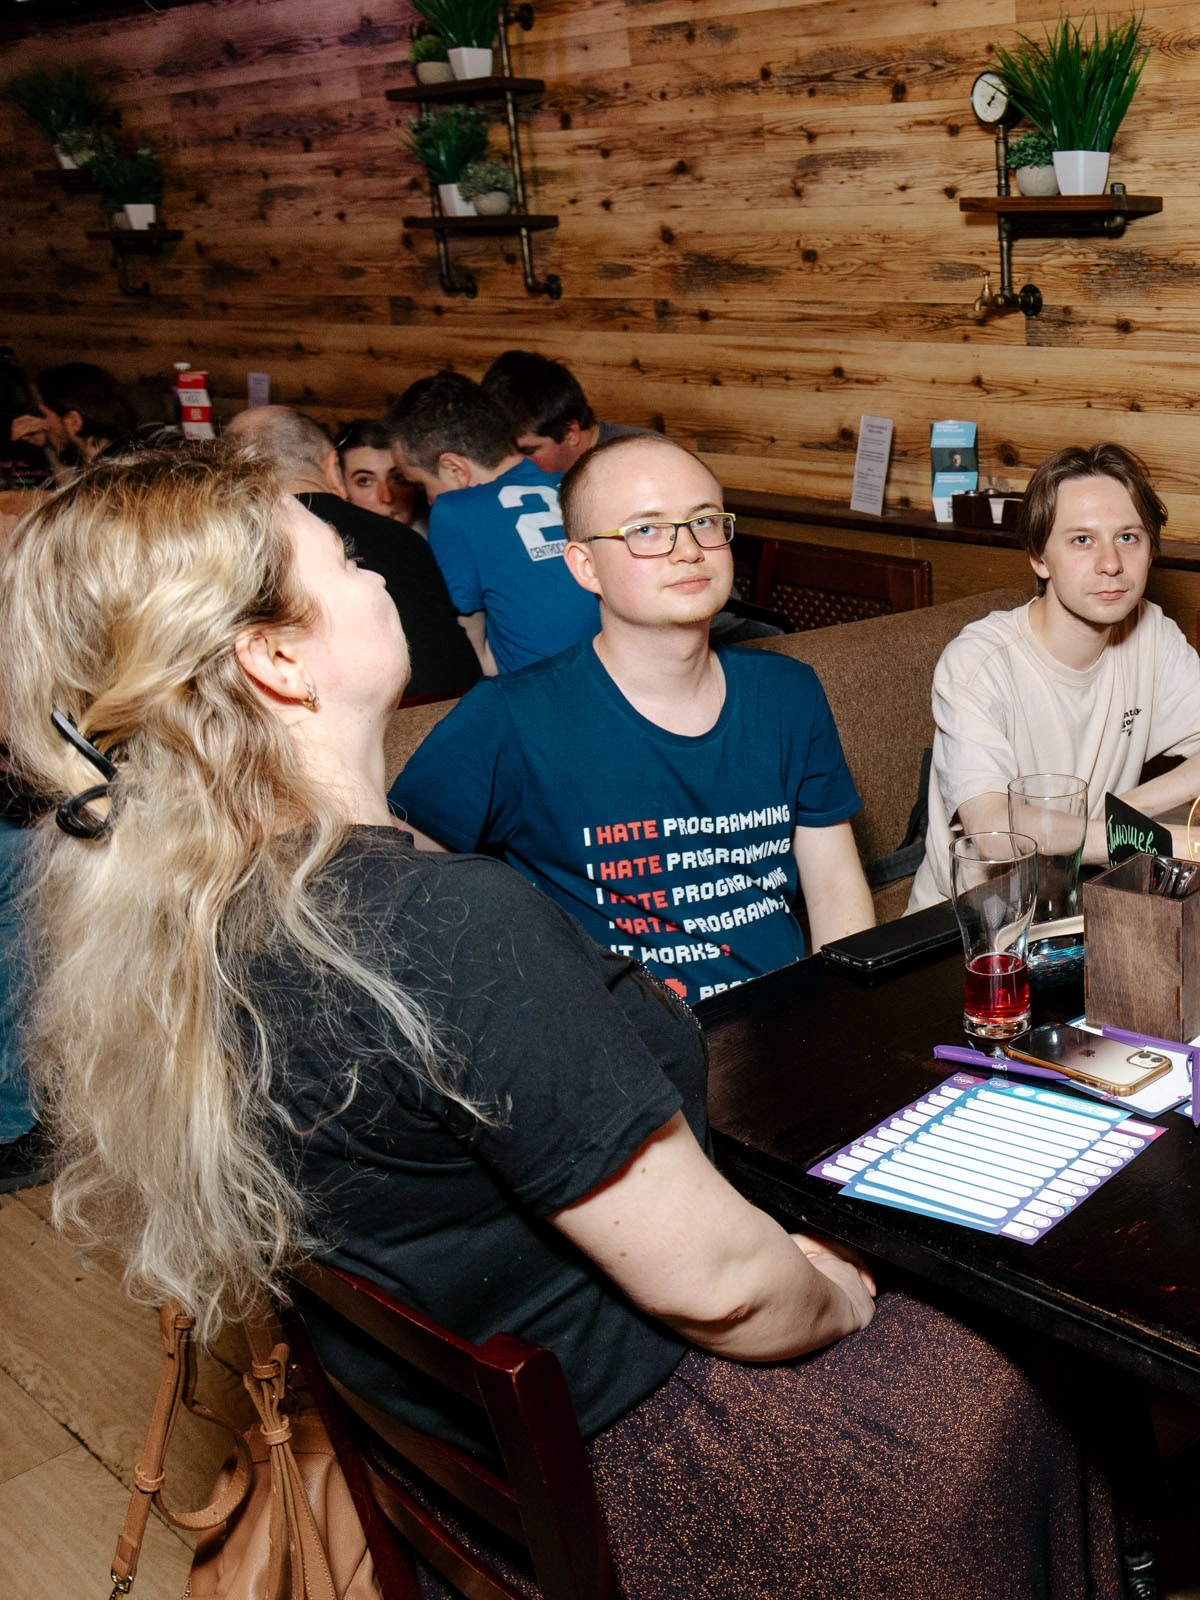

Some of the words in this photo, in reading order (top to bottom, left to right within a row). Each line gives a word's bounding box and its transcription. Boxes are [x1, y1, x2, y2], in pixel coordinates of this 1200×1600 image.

[583, 828, 591, 846] I
[596, 820, 659, 845] HATE
[663, 804, 790, 836] PROGRAMMING
[587, 863, 594, 880] I
[600, 855, 663, 881] HATE
[596, 887, 604, 905] I
